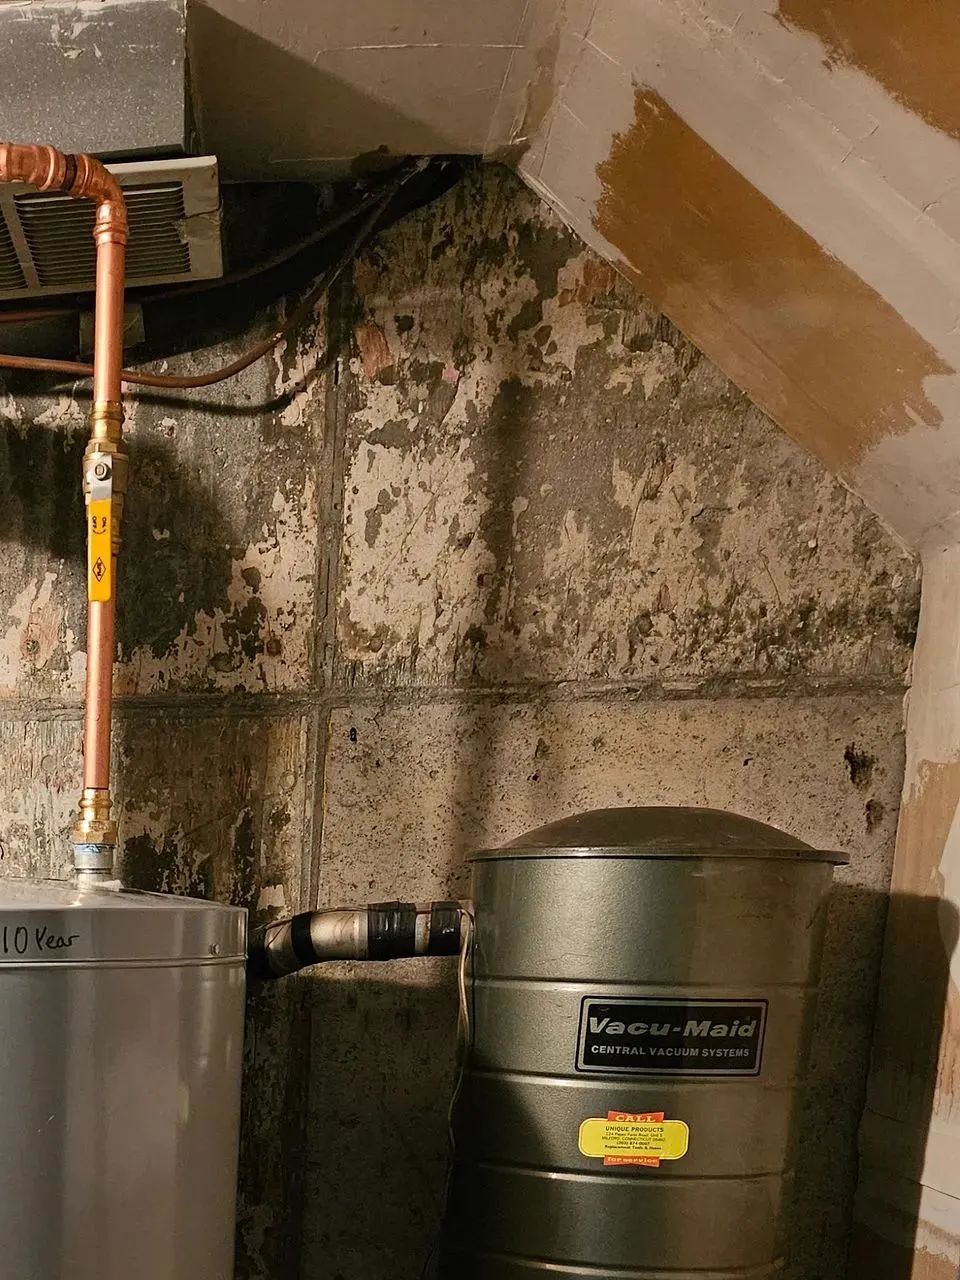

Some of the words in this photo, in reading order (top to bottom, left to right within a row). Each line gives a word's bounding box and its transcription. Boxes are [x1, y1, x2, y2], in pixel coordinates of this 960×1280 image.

[4, 926, 28, 954] 10
[35, 926, 81, 951] Year
[589, 1017, 757, 1038] Vacu-Maid
[591, 1045, 647, 1055] CENTRAL
[650, 1047, 699, 1057] VACUUM
[701, 1048, 750, 1058] SYSTEMS
[615, 1114, 657, 1123] CALL
